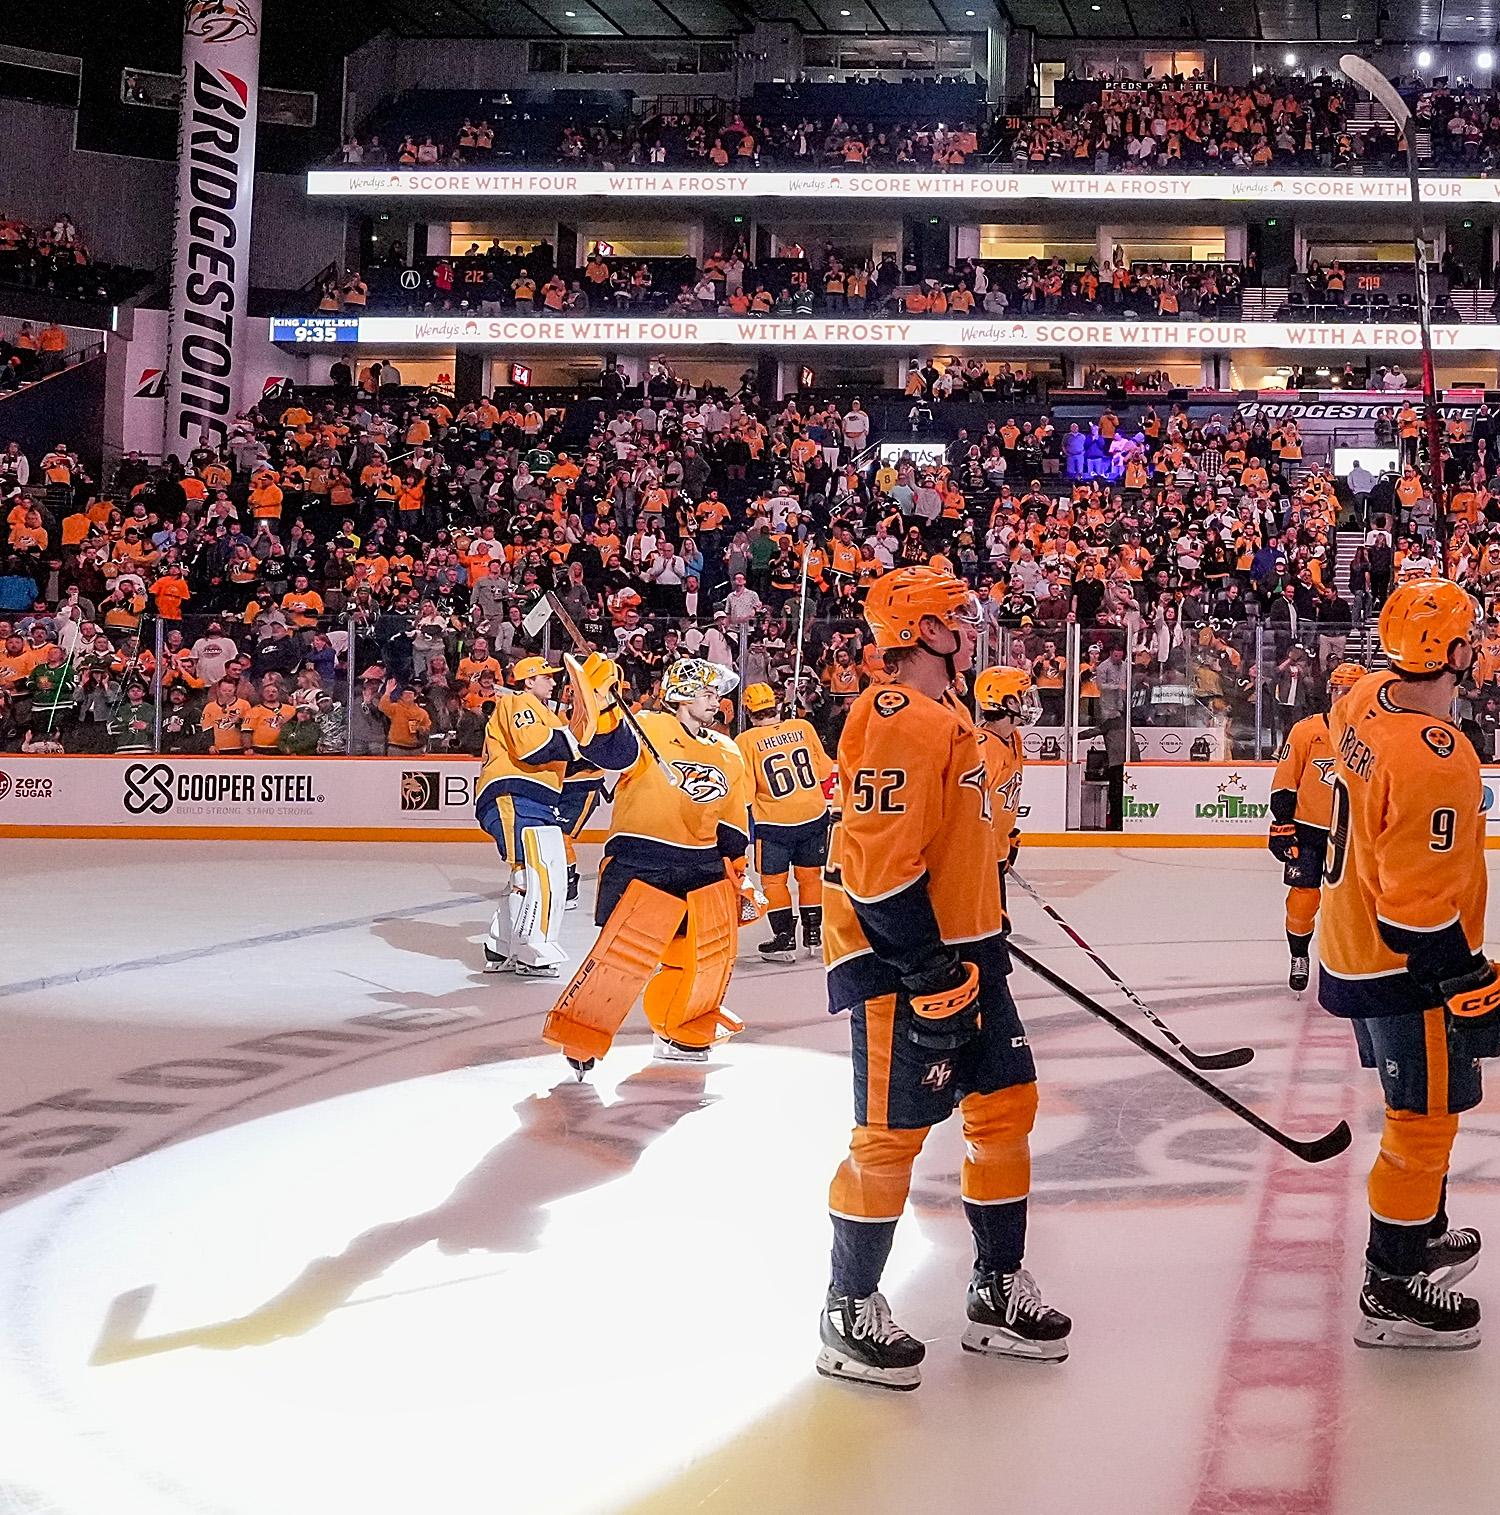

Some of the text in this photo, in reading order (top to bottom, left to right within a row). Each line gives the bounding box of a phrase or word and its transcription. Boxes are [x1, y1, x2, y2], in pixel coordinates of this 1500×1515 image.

[409, 177, 469, 190] SCORE
[476, 177, 522, 190] WITH
[530, 177, 576, 190] FOUR
[609, 177, 748, 190] WITH A FROSTY
[849, 179, 910, 192] SCORE
[917, 179, 964, 192] WITH
[971, 180, 1018, 193] FOUR
[1051, 180, 1191, 194] WITH A FROSTY
[1293, 182, 1353, 195] SCORE
[1360, 184, 1407, 196] WITH
[1418, 184, 1461, 197] OUR
[179, 59, 248, 450] BRIDGESTONE
[464, 270, 484, 283] 212
[791, 272, 808, 284] 211
[274, 319, 359, 328] KING JEWELERS
[489, 323, 564, 339] SCORE
[571, 323, 629, 339] WITH
[639, 323, 697, 339] FOUR
[294, 327, 337, 342] 9:35
[738, 324, 910, 340] WITH A FROSTY
[1036, 326, 1112, 342] SCORE
[1119, 327, 1178, 343] WITH
[1187, 327, 1246, 343] FOUR
[1286, 328, 1459, 346] WITH A FROTY
[513, 708, 536, 729] 29
[756, 729, 805, 753] L'HEUREUX
[762, 747, 817, 799] 68
[15, 778, 53, 790] zero
[177, 774, 258, 801] COOPER
[853, 768, 907, 815] 52
[15, 789, 52, 798] SUGAR
[176, 806, 203, 815] BUILD
[246, 806, 275, 815] STAND
[1195, 794, 1269, 818] LOTTERY
[1428, 806, 1457, 853] 9
[559, 958, 596, 1010] TRUE
